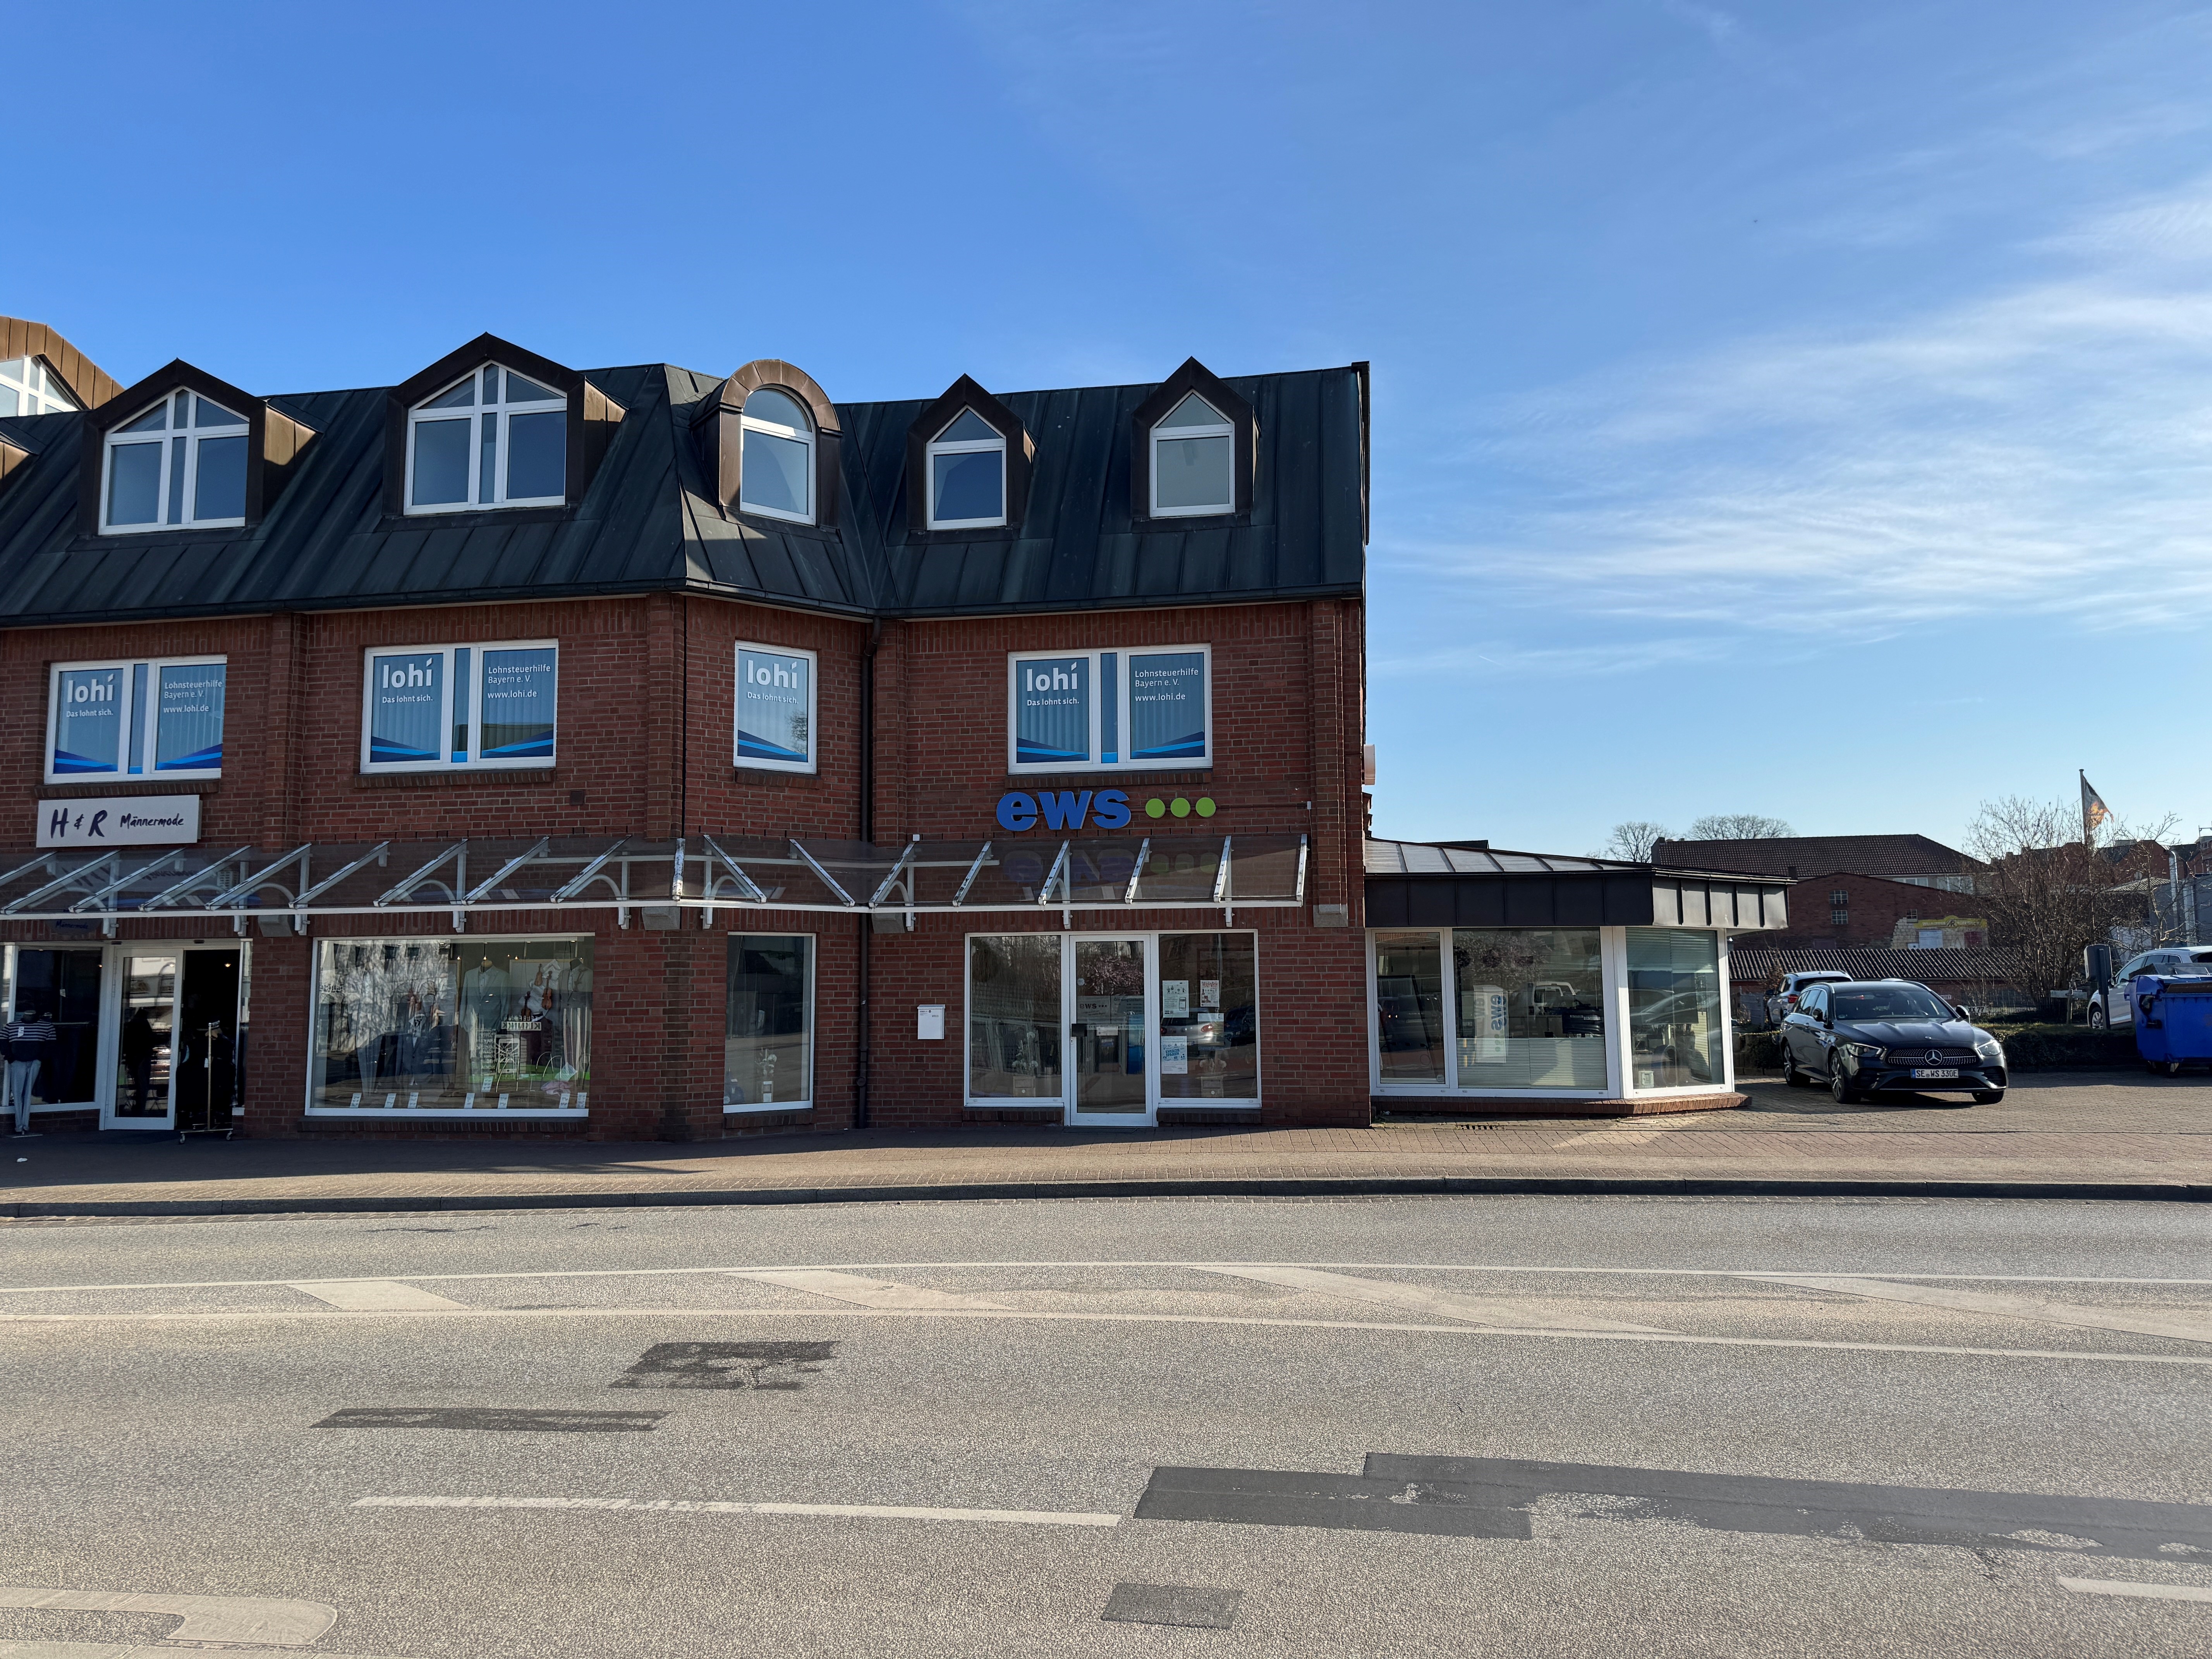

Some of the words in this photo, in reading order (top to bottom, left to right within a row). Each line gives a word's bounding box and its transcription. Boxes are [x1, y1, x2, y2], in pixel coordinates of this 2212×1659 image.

[383, 658, 432, 688] lohi
[489, 665, 550, 674] Lohnsteuerhilfe
[1135, 668, 1199, 678] Lohnsteuerhilfe
[747, 660, 797, 689] lohi
[1027, 662, 1077, 691] lohi
[165, 680, 222, 689] Lohnsteuerhilfe
[488, 676, 514, 685] Bayern
[1135, 679, 1162, 688] Bayern
[67, 674, 113, 702] lohi
[164, 690, 189, 699] Bayern
[488, 690, 537, 698] www.lohi.de
[763, 693, 781, 702] lohnt
[1135, 693, 1185, 701] www.lohi.de
[80, 709, 97, 717] lohnt
[163, 704, 209, 713] www.lohi.de
[996, 790, 1132, 831] ews
[50, 808, 69, 838] H
[74, 814, 84, 829] &
[88, 810, 107, 837] R
[120, 813, 184, 828] Männermode
